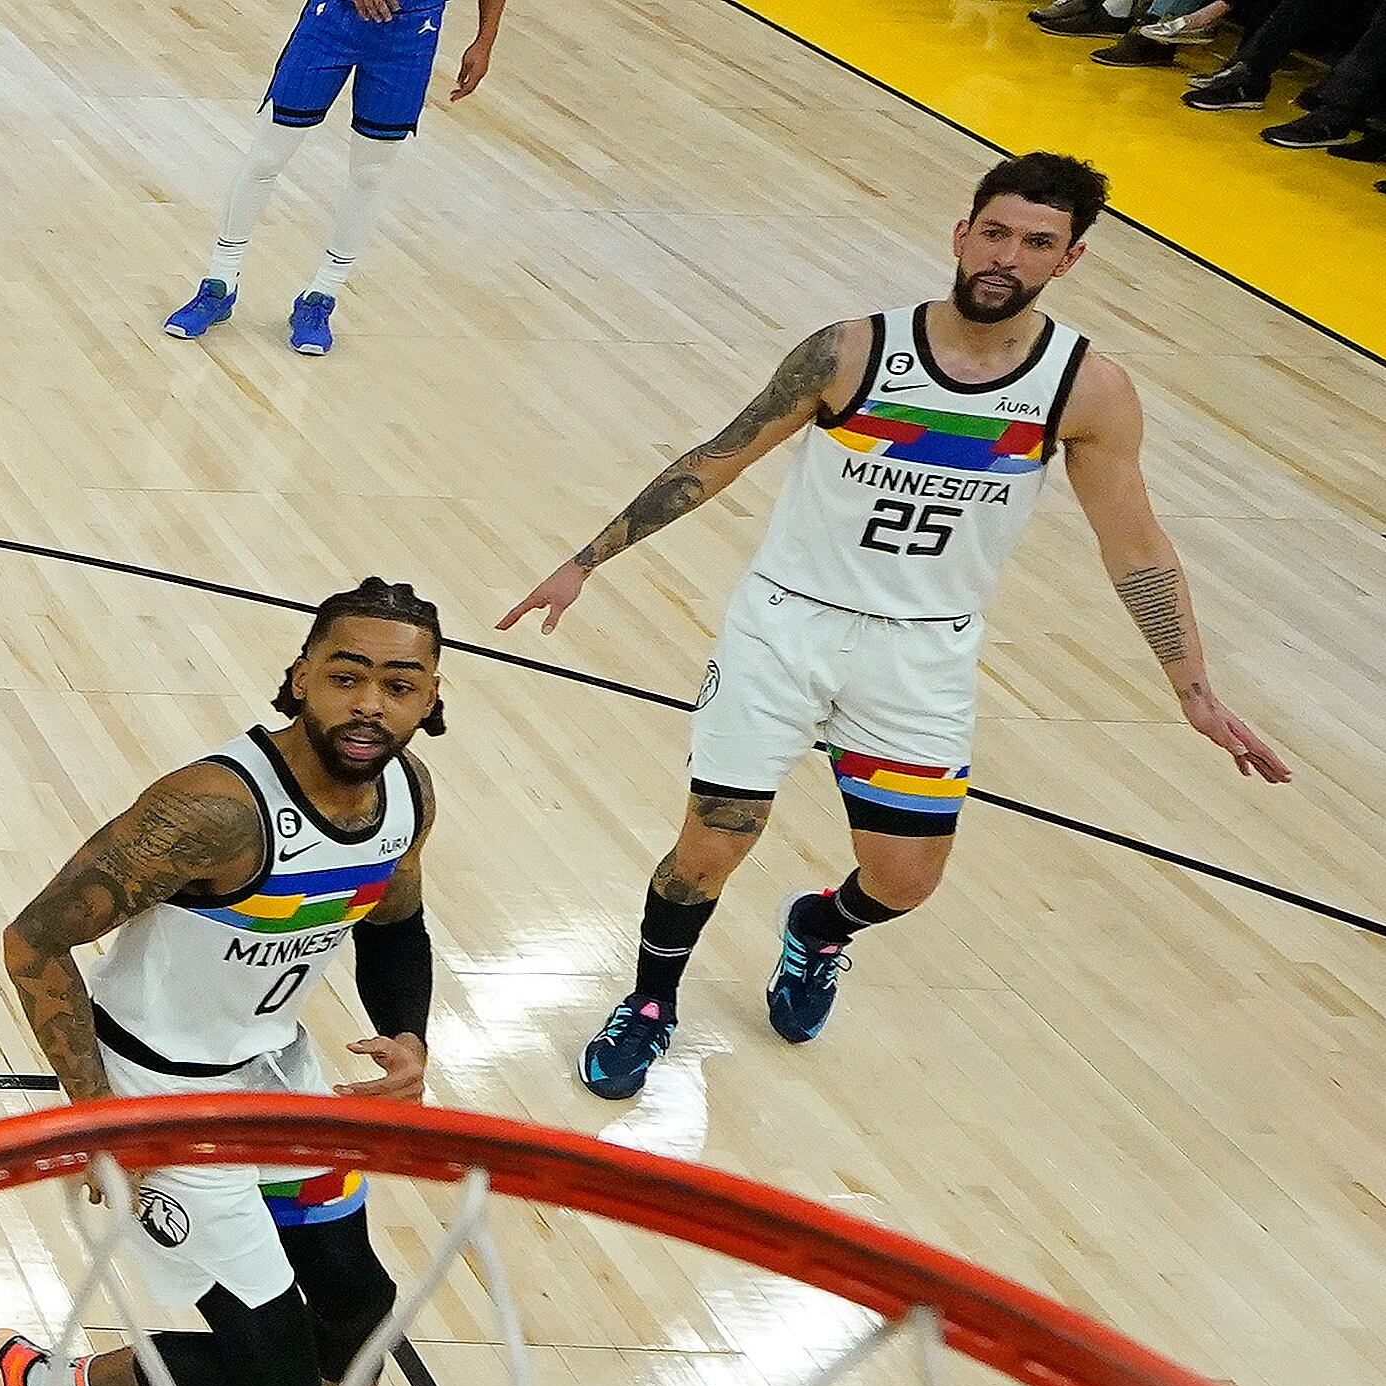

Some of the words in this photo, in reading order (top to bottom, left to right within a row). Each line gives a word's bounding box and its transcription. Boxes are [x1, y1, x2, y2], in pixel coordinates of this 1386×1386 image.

[888, 354, 911, 374] 6
[841, 457, 1011, 506] MINNESOTA
[859, 498, 964, 556] 25
[279, 809, 299, 836] 6
[254, 963, 311, 1017] 0
